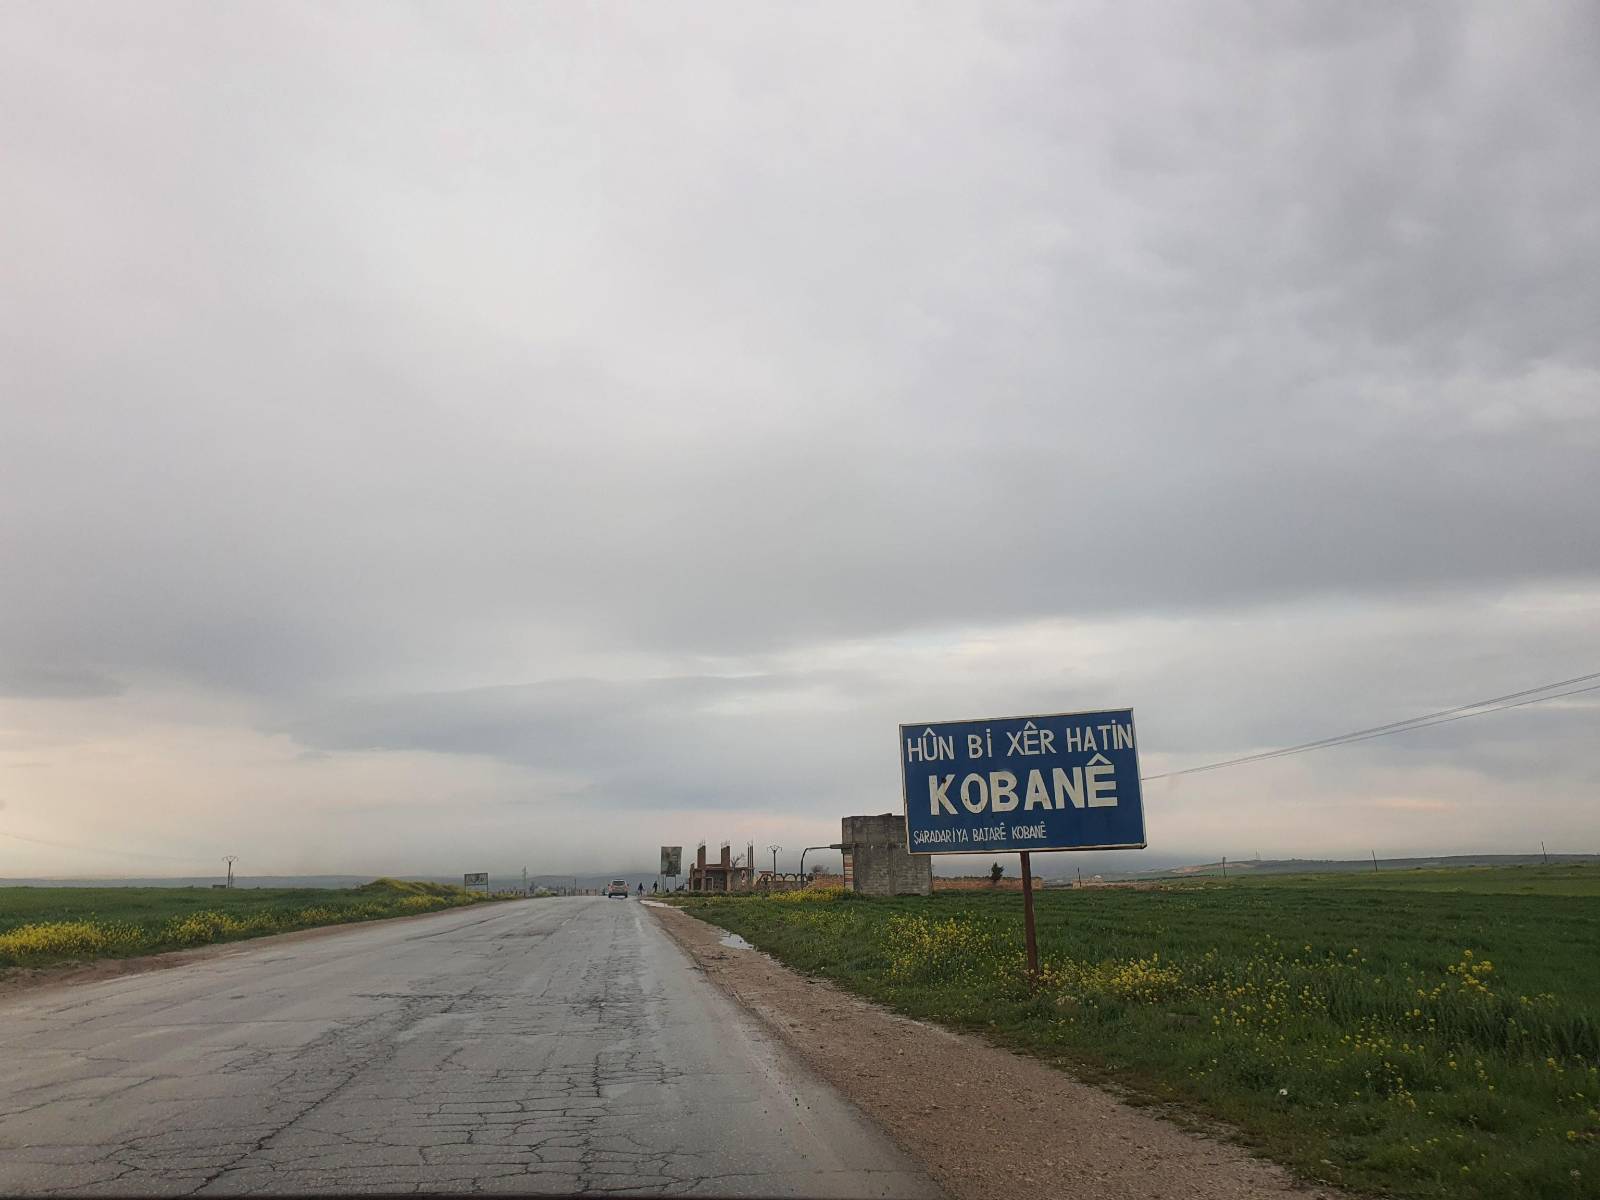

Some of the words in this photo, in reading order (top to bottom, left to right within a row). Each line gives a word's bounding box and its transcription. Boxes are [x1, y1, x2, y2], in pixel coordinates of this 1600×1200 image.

[907, 727, 954, 762] HÛN
[1006, 721, 1057, 757] XÊR
[928, 753, 1118, 815] KOBANÊ
[1011, 821, 1047, 840] KOBANÊ
